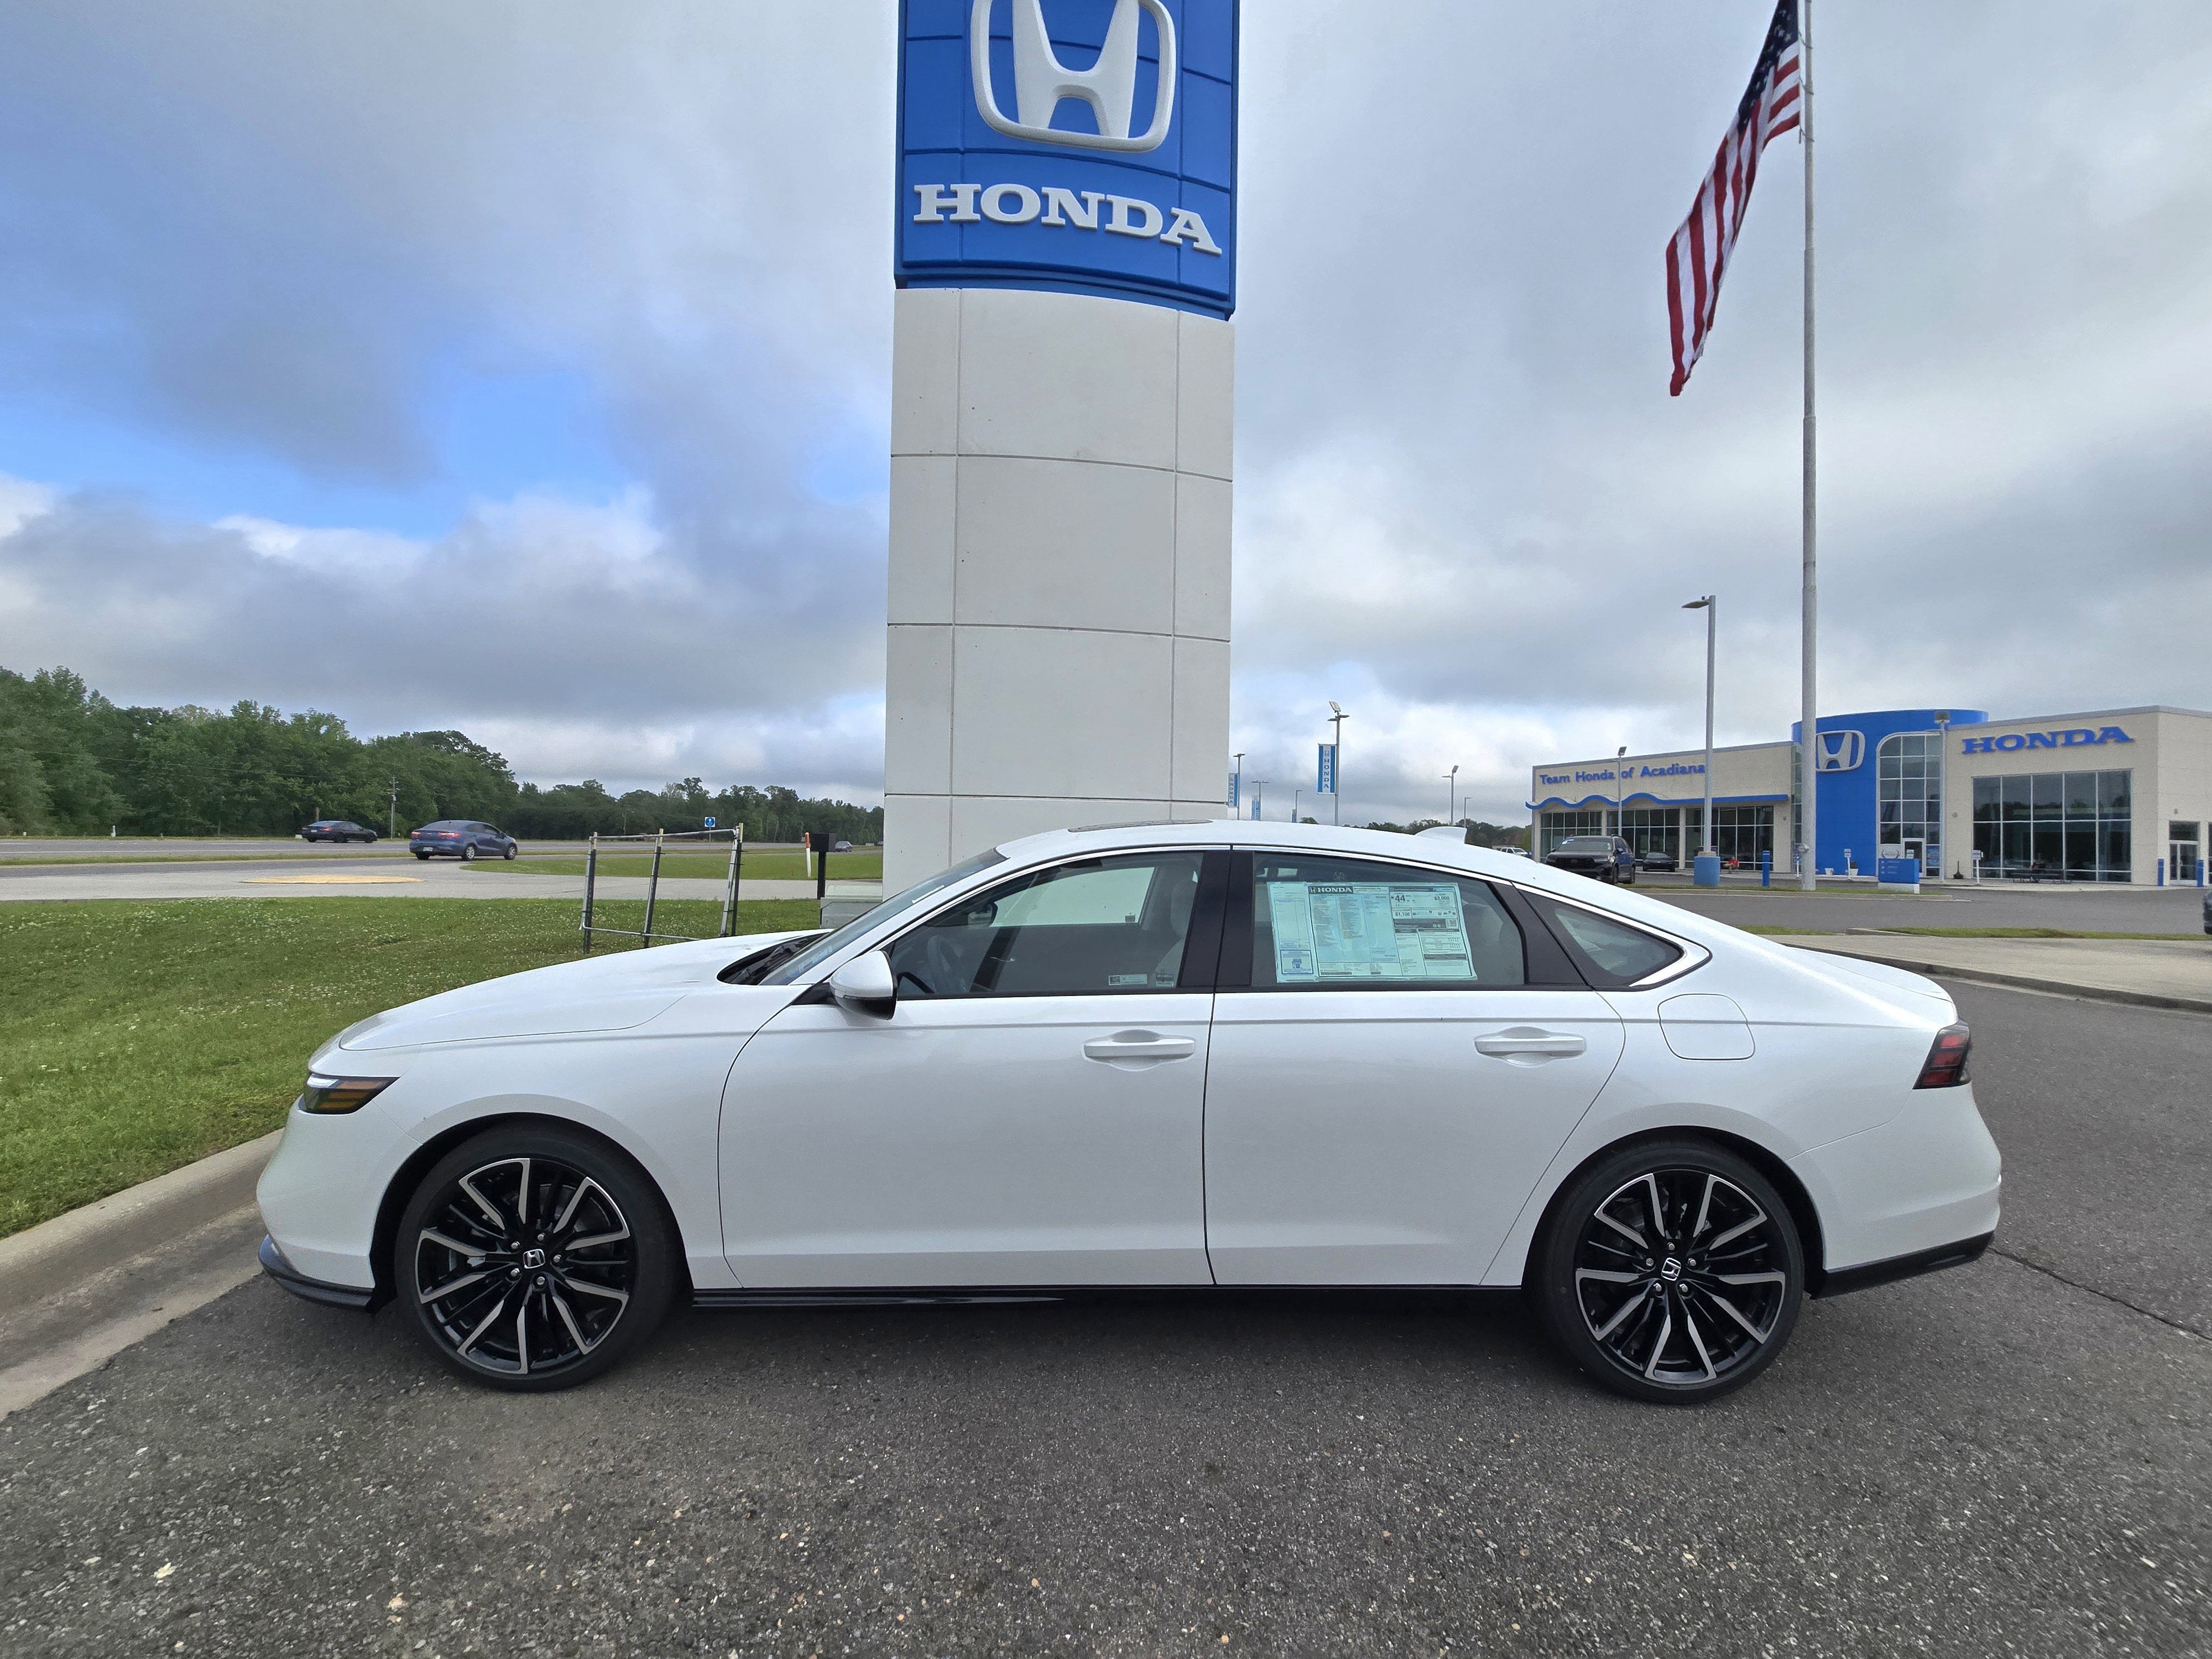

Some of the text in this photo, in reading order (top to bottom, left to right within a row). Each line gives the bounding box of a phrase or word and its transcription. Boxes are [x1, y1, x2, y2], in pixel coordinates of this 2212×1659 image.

[913, 182, 1223, 255] HONDA
[1961, 726, 2135, 754] HONDA
[1540, 763, 1706, 784] Team Honda of Acadiana
